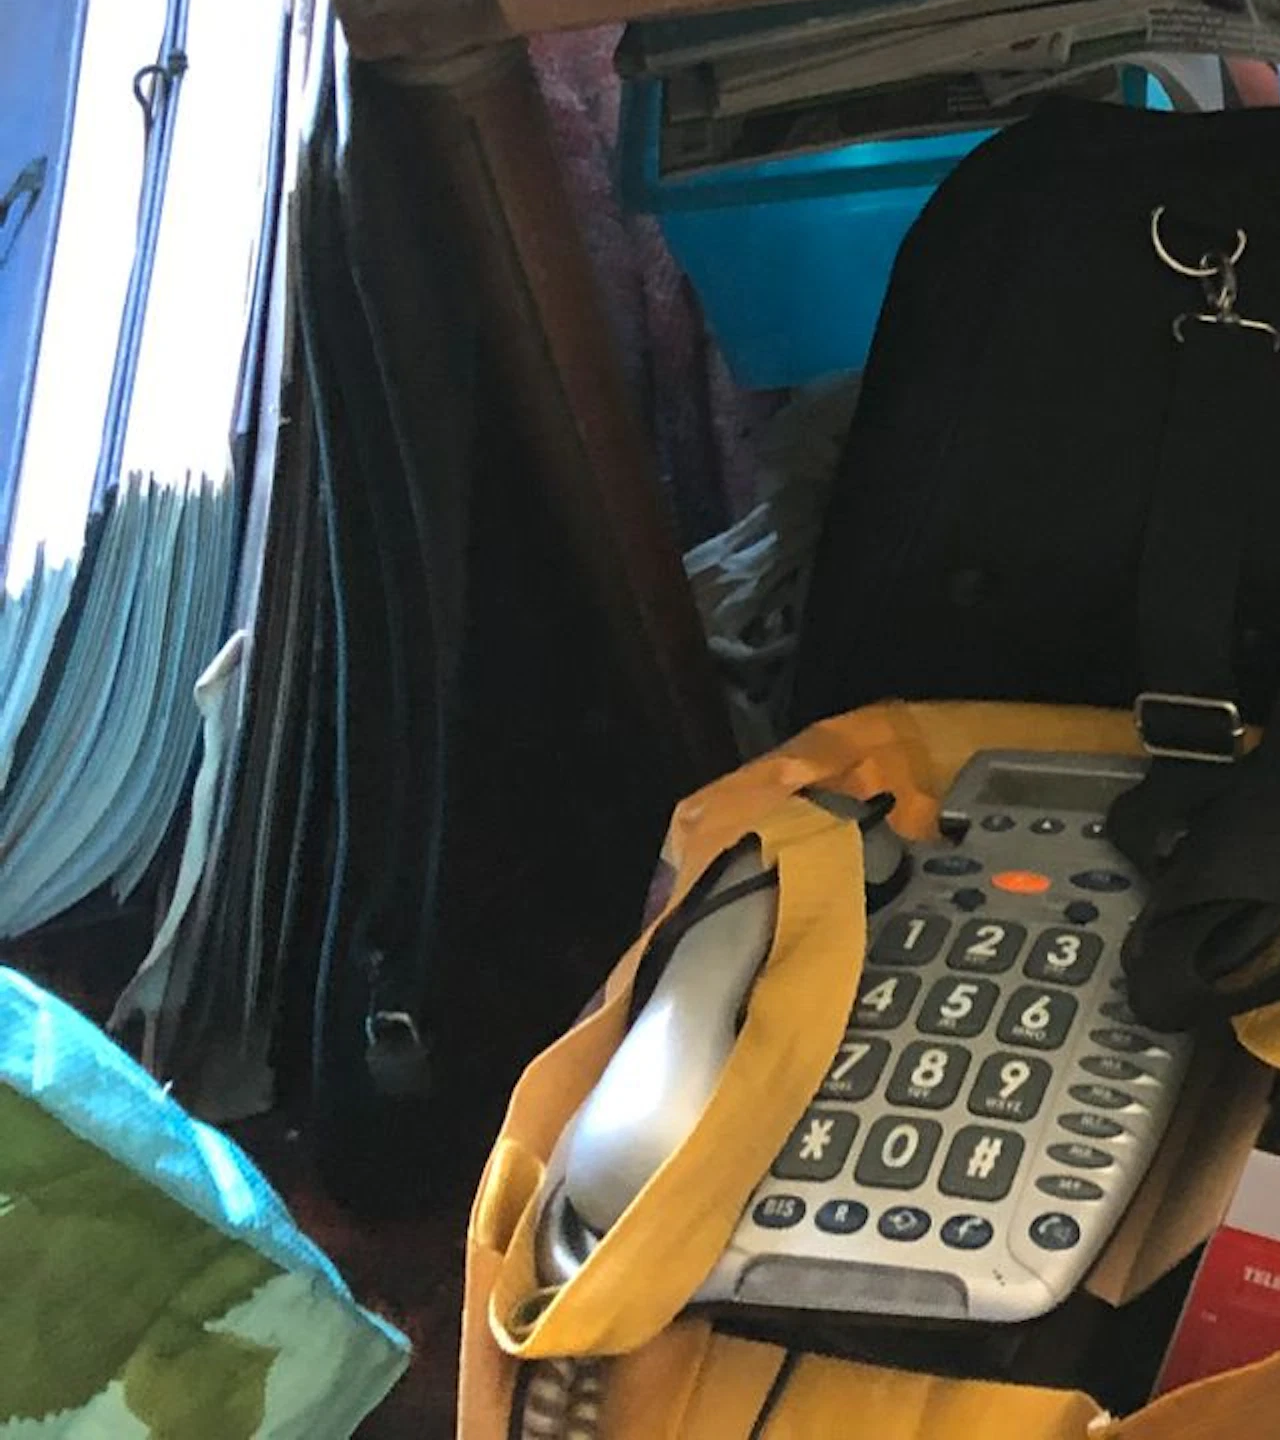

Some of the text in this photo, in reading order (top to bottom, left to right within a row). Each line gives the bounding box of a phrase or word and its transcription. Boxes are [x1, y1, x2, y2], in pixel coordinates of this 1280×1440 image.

[902, 920, 1081, 968] 1 2 3
[862, 978, 1051, 1030] 4 5 6
[832, 1042, 1031, 1098] 7 8 9
[881, 1124, 918, 1167] 0
[764, 1197, 847, 1221] BIS R
